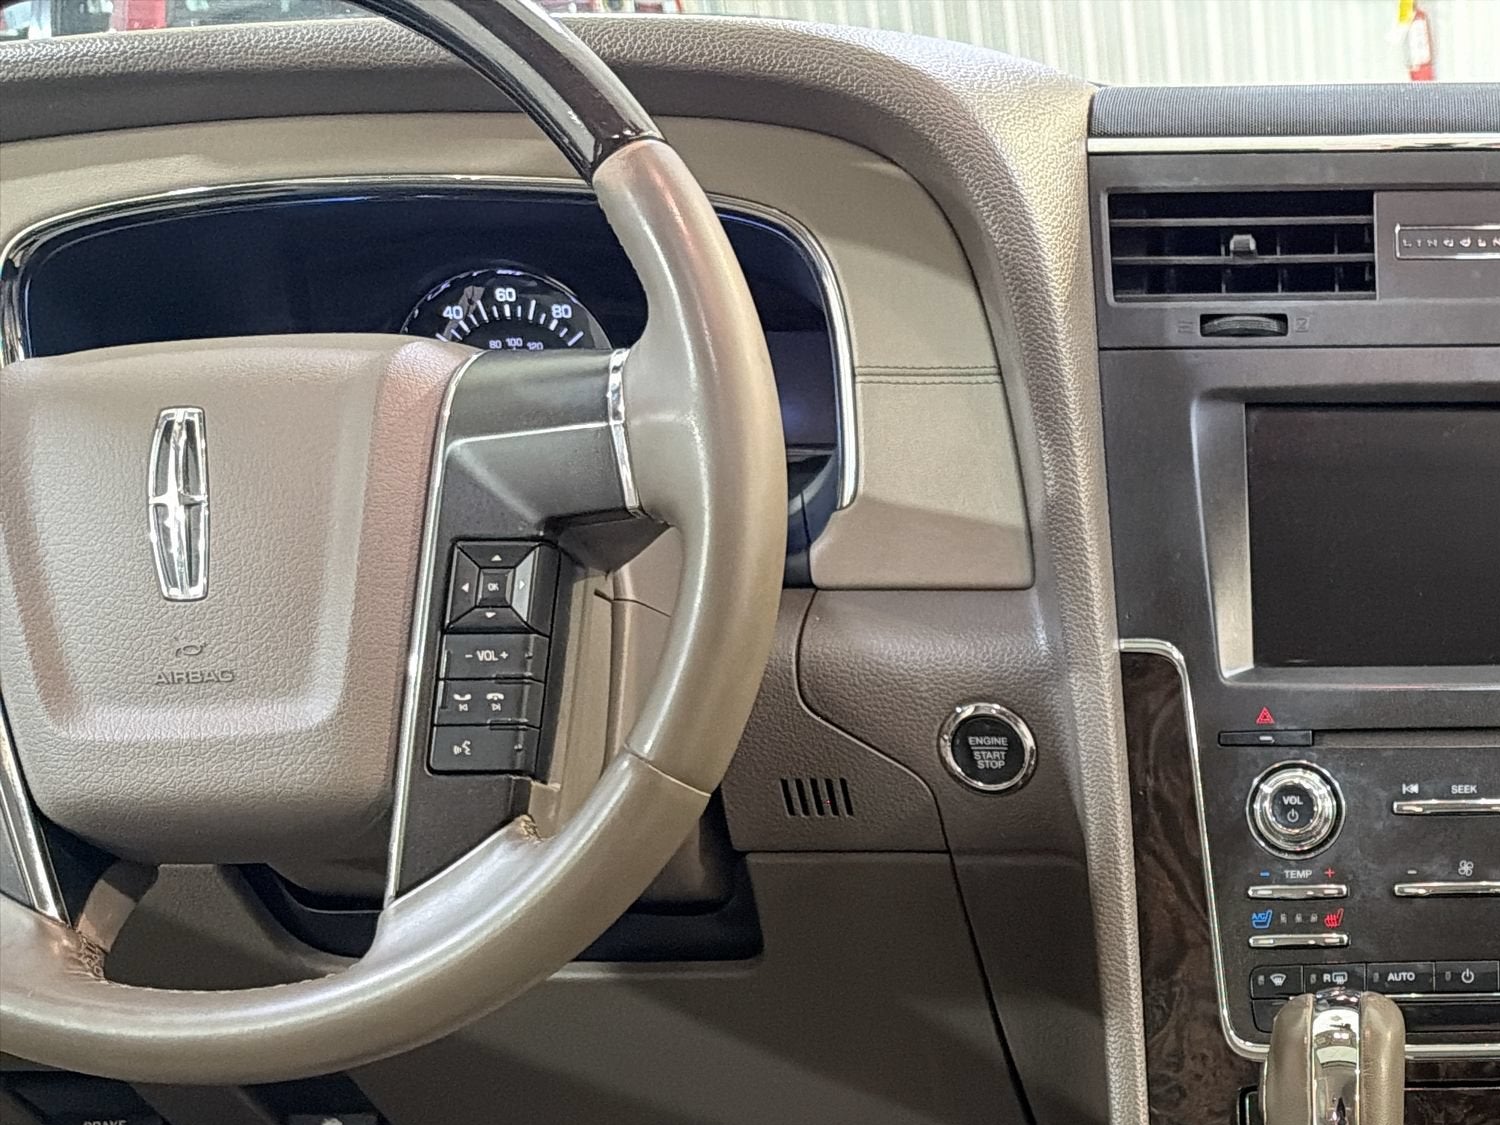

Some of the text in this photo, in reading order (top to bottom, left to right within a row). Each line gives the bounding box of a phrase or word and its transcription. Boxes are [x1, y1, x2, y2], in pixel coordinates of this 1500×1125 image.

[495, 287, 516, 302] 60
[443, 305, 464, 320] 40
[551, 304, 572, 319] 80
[489, 339, 502, 349] 80
[506, 337, 523, 347] 100
[527, 341, 544, 350] 120
[487, 582, 499, 592] OK
[477, 650, 499, 662] VOL
[155, 670, 235, 685] AIRBAG
[968, 736, 1008, 746] ENGINE
[974, 750, 1006, 760] START
[977, 760, 1005, 769] STOP
[1450, 784, 1478, 794] SEEK
[1282, 795, 1304, 806] VOL
[1284, 869, 1313, 879] TEMP
[1323, 973, 1331, 983] R
[1387, 971, 1416, 982] AUTO
